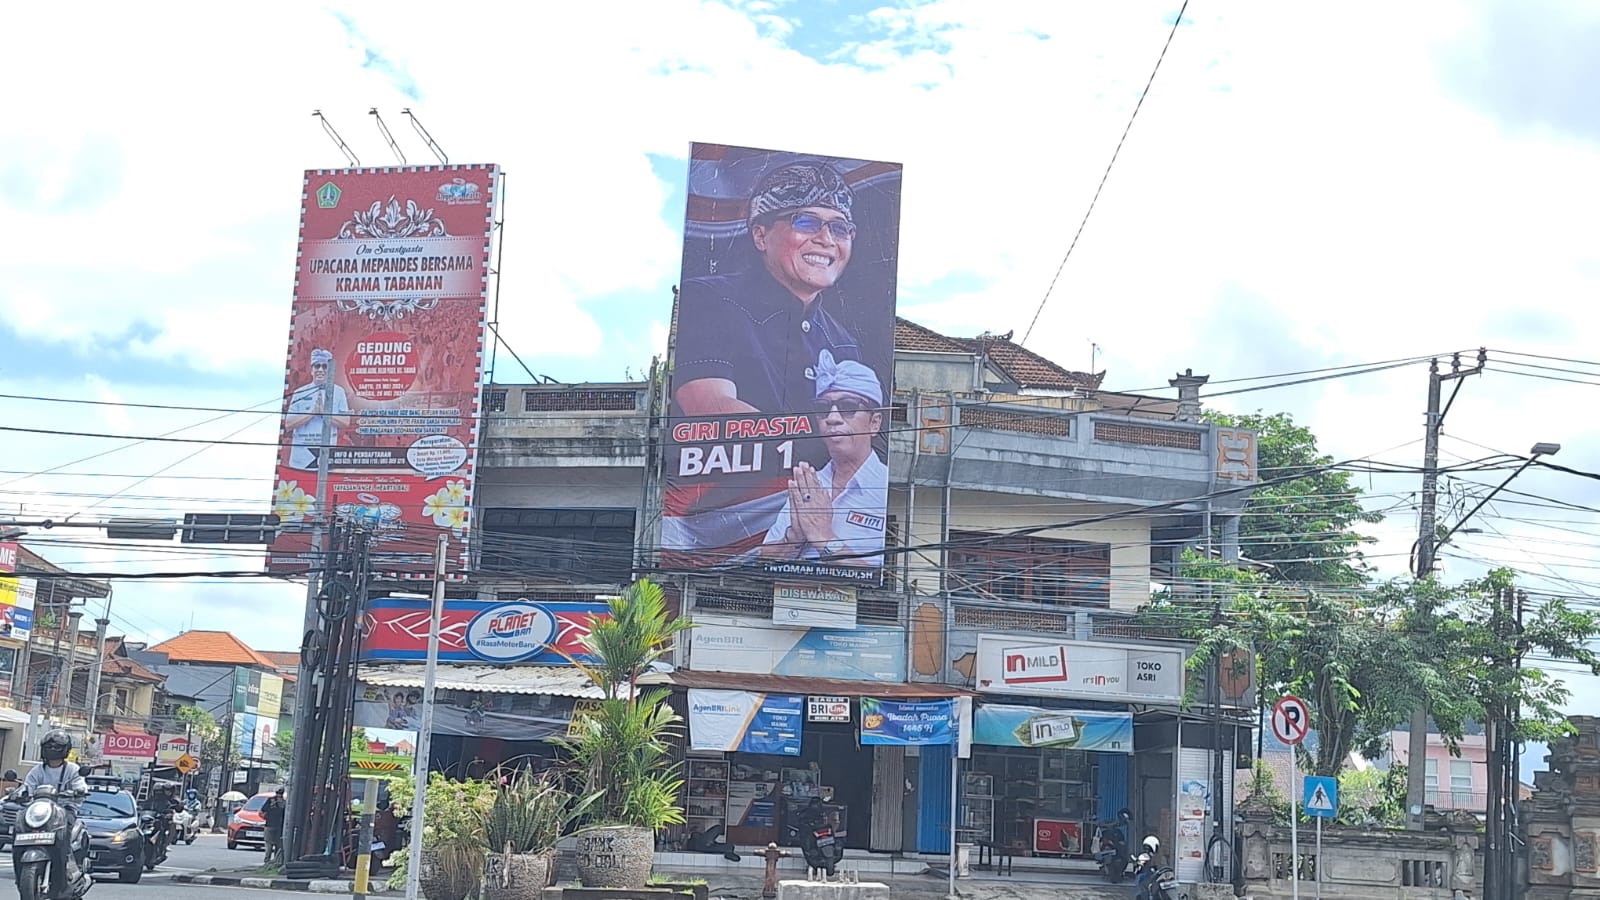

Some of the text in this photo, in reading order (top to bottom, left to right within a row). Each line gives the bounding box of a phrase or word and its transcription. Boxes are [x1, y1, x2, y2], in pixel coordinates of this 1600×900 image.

[355, 244, 373, 256] Om
[309, 255, 473, 274] UPACARA MEPANDES BERSAMA
[335, 275, 443, 292] KRAMA TABANAN
[357, 341, 412, 354] GEDUNG
[360, 354, 406, 366] MARIO
[673, 415, 812, 442] GIRI PRASTA
[679, 441, 793, 476] BALI 1
[488, 611, 538, 633] PLANET
[476, 640, 535, 648] #RasaMotorBaru
[1027, 655, 1059, 669] MILD
[1136, 661, 1162, 671] TOKO
[1136, 672, 1156, 682] ASRI
[811, 704, 828, 714] BRI
[919, 712, 948, 721] Puasa
